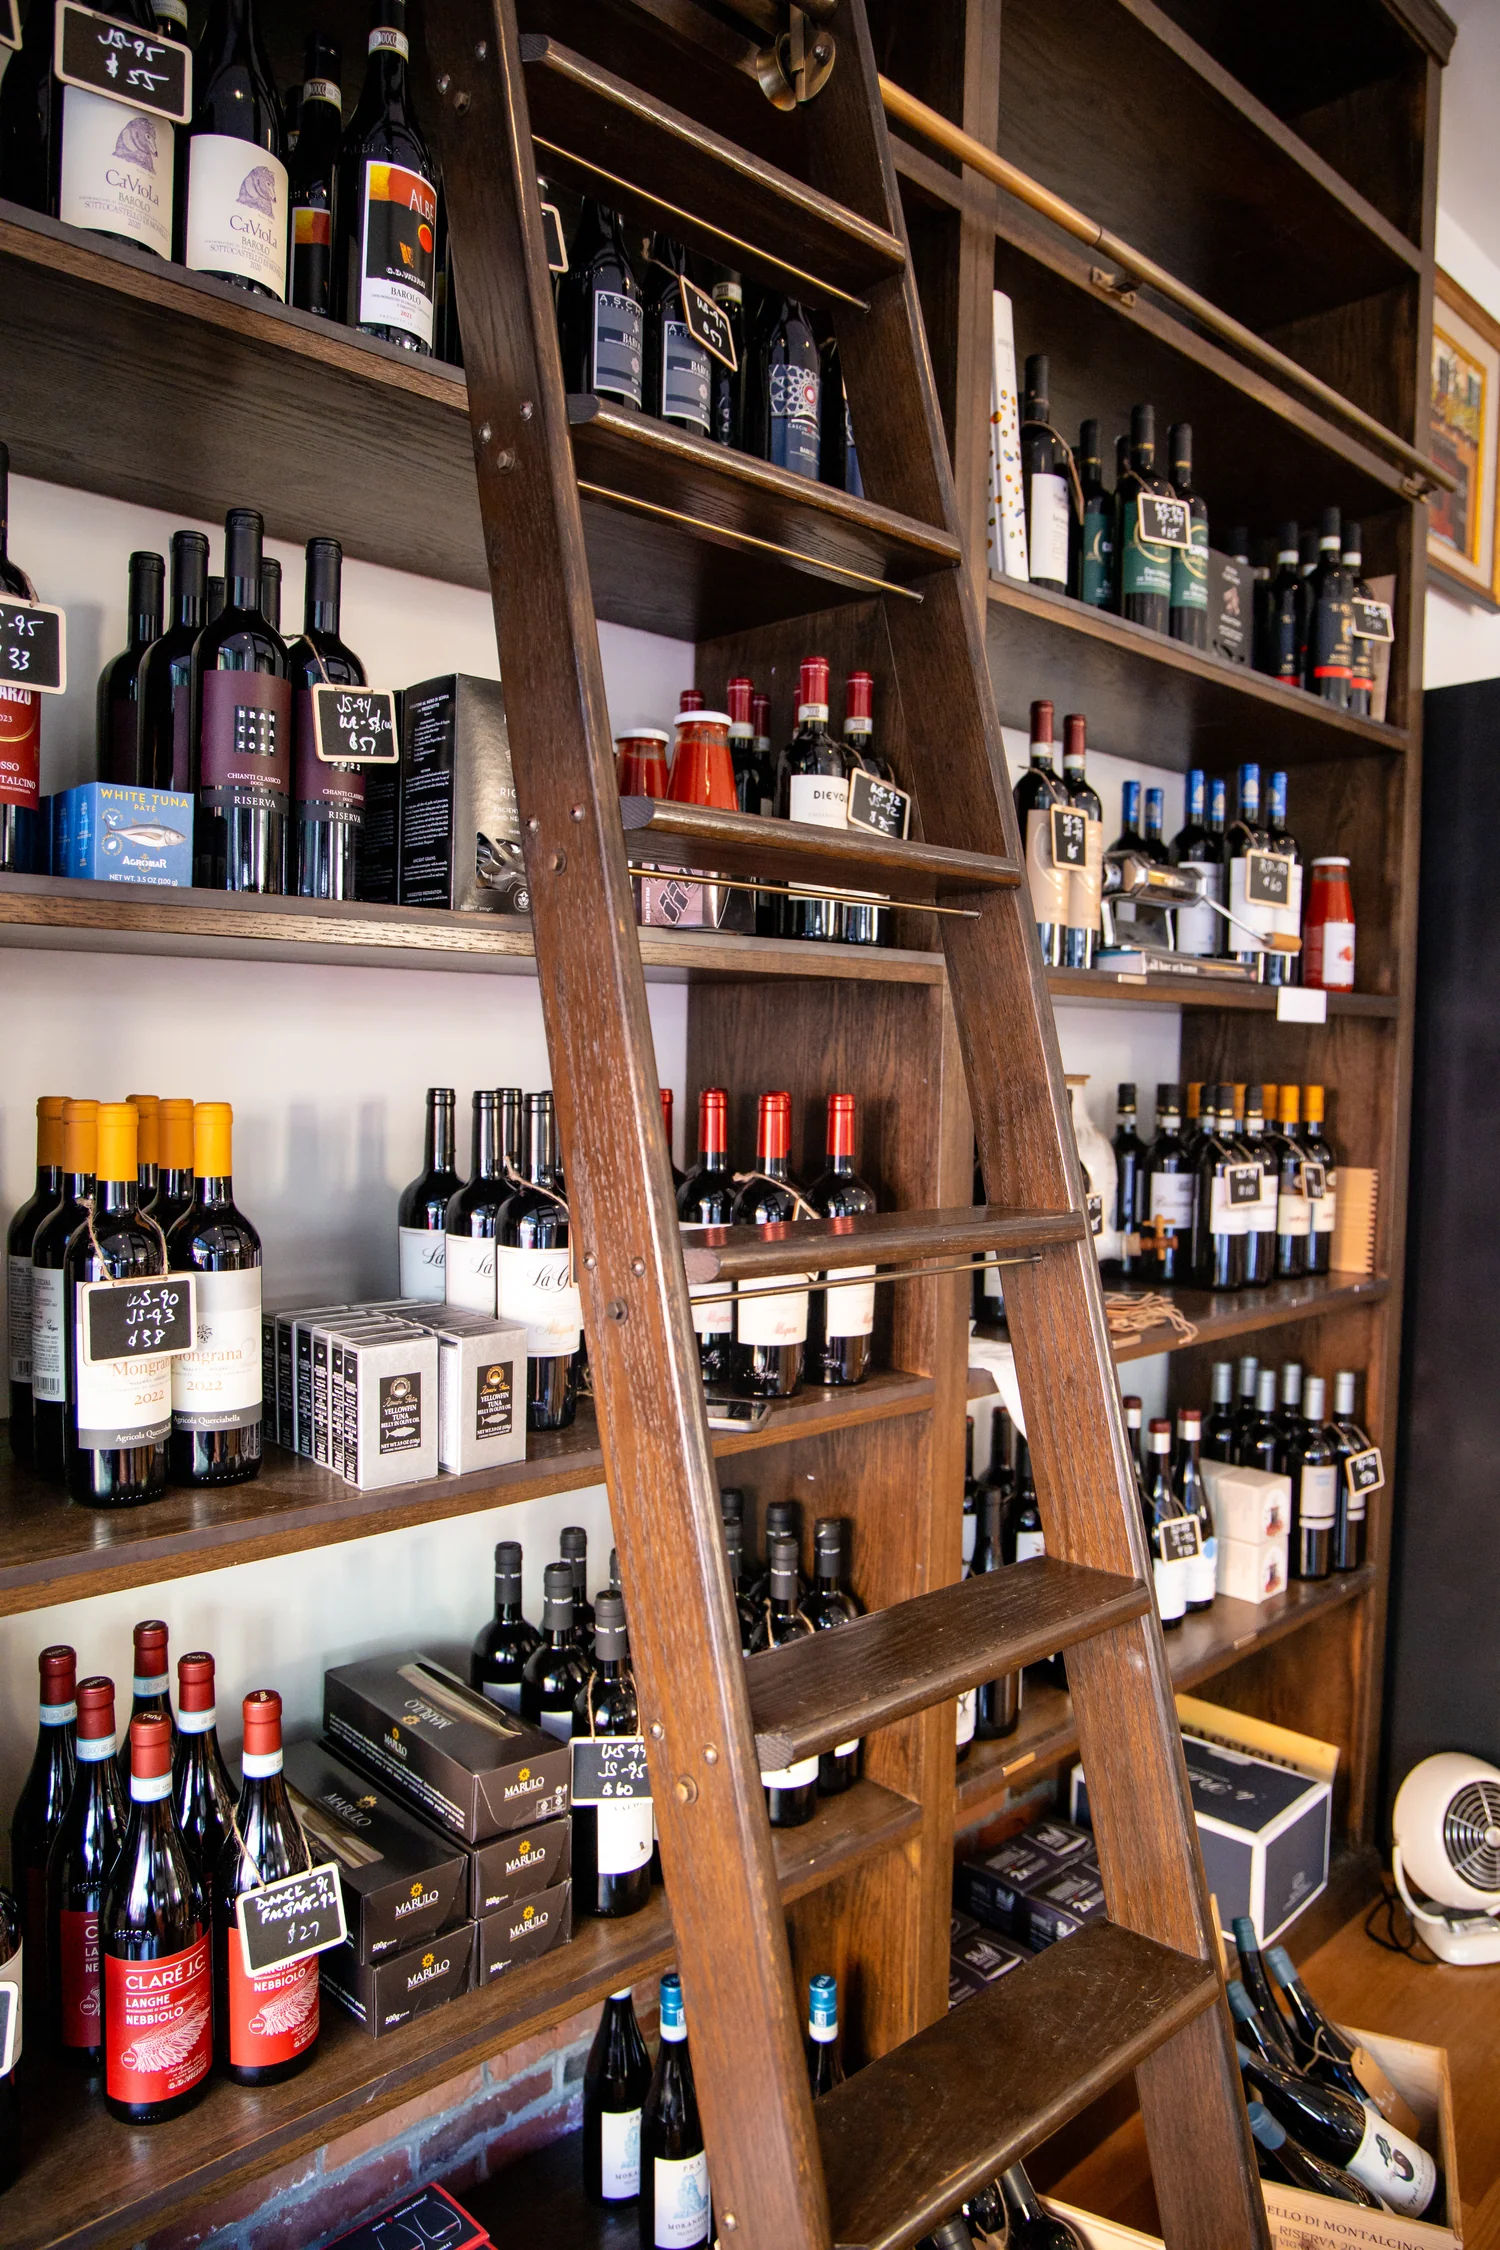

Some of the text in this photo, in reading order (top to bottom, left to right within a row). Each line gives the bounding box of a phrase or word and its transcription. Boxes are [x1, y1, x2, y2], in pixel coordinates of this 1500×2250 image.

[119, 192, 151, 213] BAROLO
[241, 236, 270, 256] BAROLO
[390, 286, 422, 306] BAROLO
[238, 709, 276, 723] BRAN
[238, 725, 276, 738] CAIA
[238, 740, 276, 753] 2022
[227, 772, 256, 781] CHIANTI
[101, 788, 189, 808] WHITE TUNA
[322, 788, 345, 797] CHIANTI
[234, 795, 277, 808] RISERVA
[328, 810, 361, 823] RISERVA
[109, 873, 123, 881] NET
[186, 1380, 224, 1391] 2022
[134, 1390, 166, 1406] 2022
[488, 1399, 502, 1408] TUNA
[384, 1404, 417, 1416] YELLOWFIN
[392, 1412, 409, 1421] TUNA
[173, 1413, 241, 1426] Agricola Querciabella
[115, 1431, 145, 1444] Agricola
[504, 1776, 545, 1798] MARULO
[323, 1792, 373, 1828] MARULO
[506, 1848, 546, 1873] MARULO
[395, 1890, 439, 1917] MARULO
[485, 1895, 501, 1906] 500g
[509, 1911, 549, 1938] MARULO
[372, 1939, 388, 1951] 500g
[125, 1963, 183, 1990] CLARÉ
[253, 1967, 306, 1992] NEBBIOLO
[407, 1959, 450, 1988] MARULO
[125, 1993, 171, 2009] LANGHE
[125, 2006, 184, 2025] NEBBIOLO
[385, 2011, 401, 2025] 500g
[1305, 2215, 1320, 2227] DI
[1279, 2225, 1337, 2250] RISERVA
